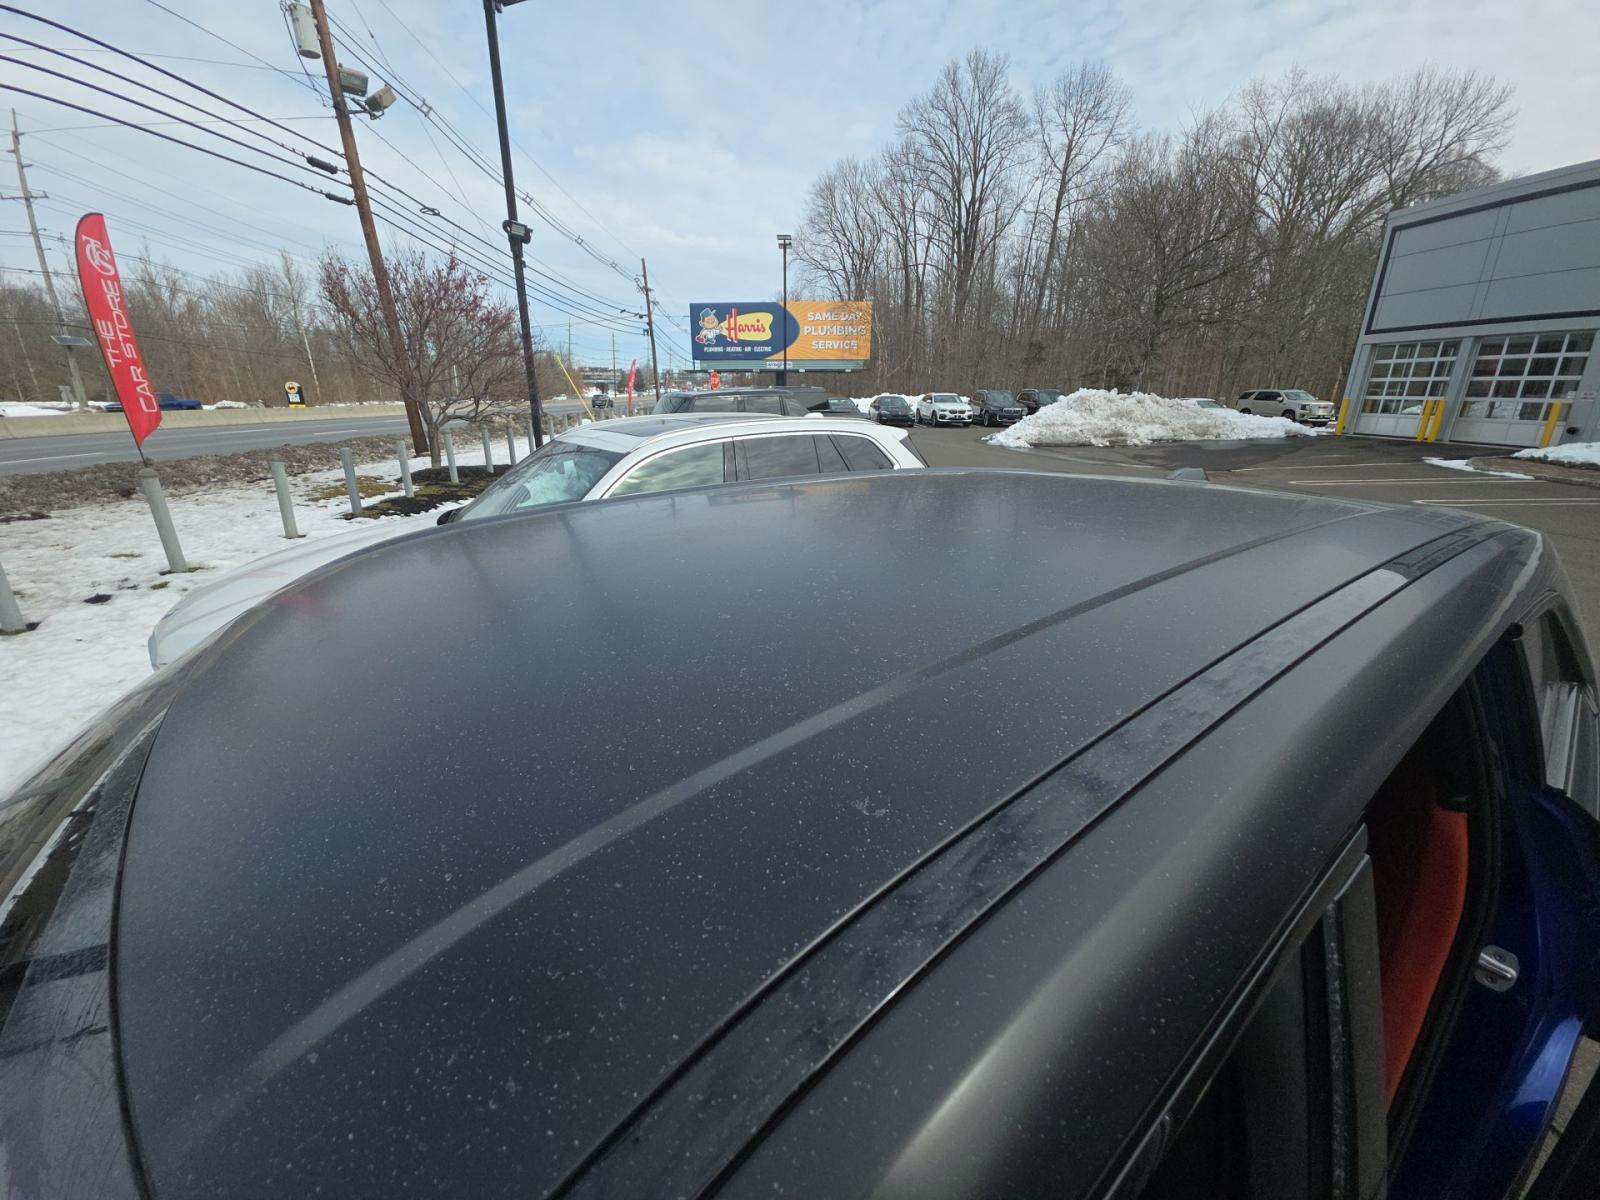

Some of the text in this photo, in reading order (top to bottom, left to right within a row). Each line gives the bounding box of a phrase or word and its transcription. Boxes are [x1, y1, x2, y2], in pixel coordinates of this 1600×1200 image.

[726, 308, 766, 343] Harris
[808, 311, 864, 321] SAME DAY
[803, 325, 866, 336] PLUMBING
[97, 319, 122, 368] THE
[101, 279, 158, 413] CAR STORE
[812, 340, 858, 350] SERVICE
